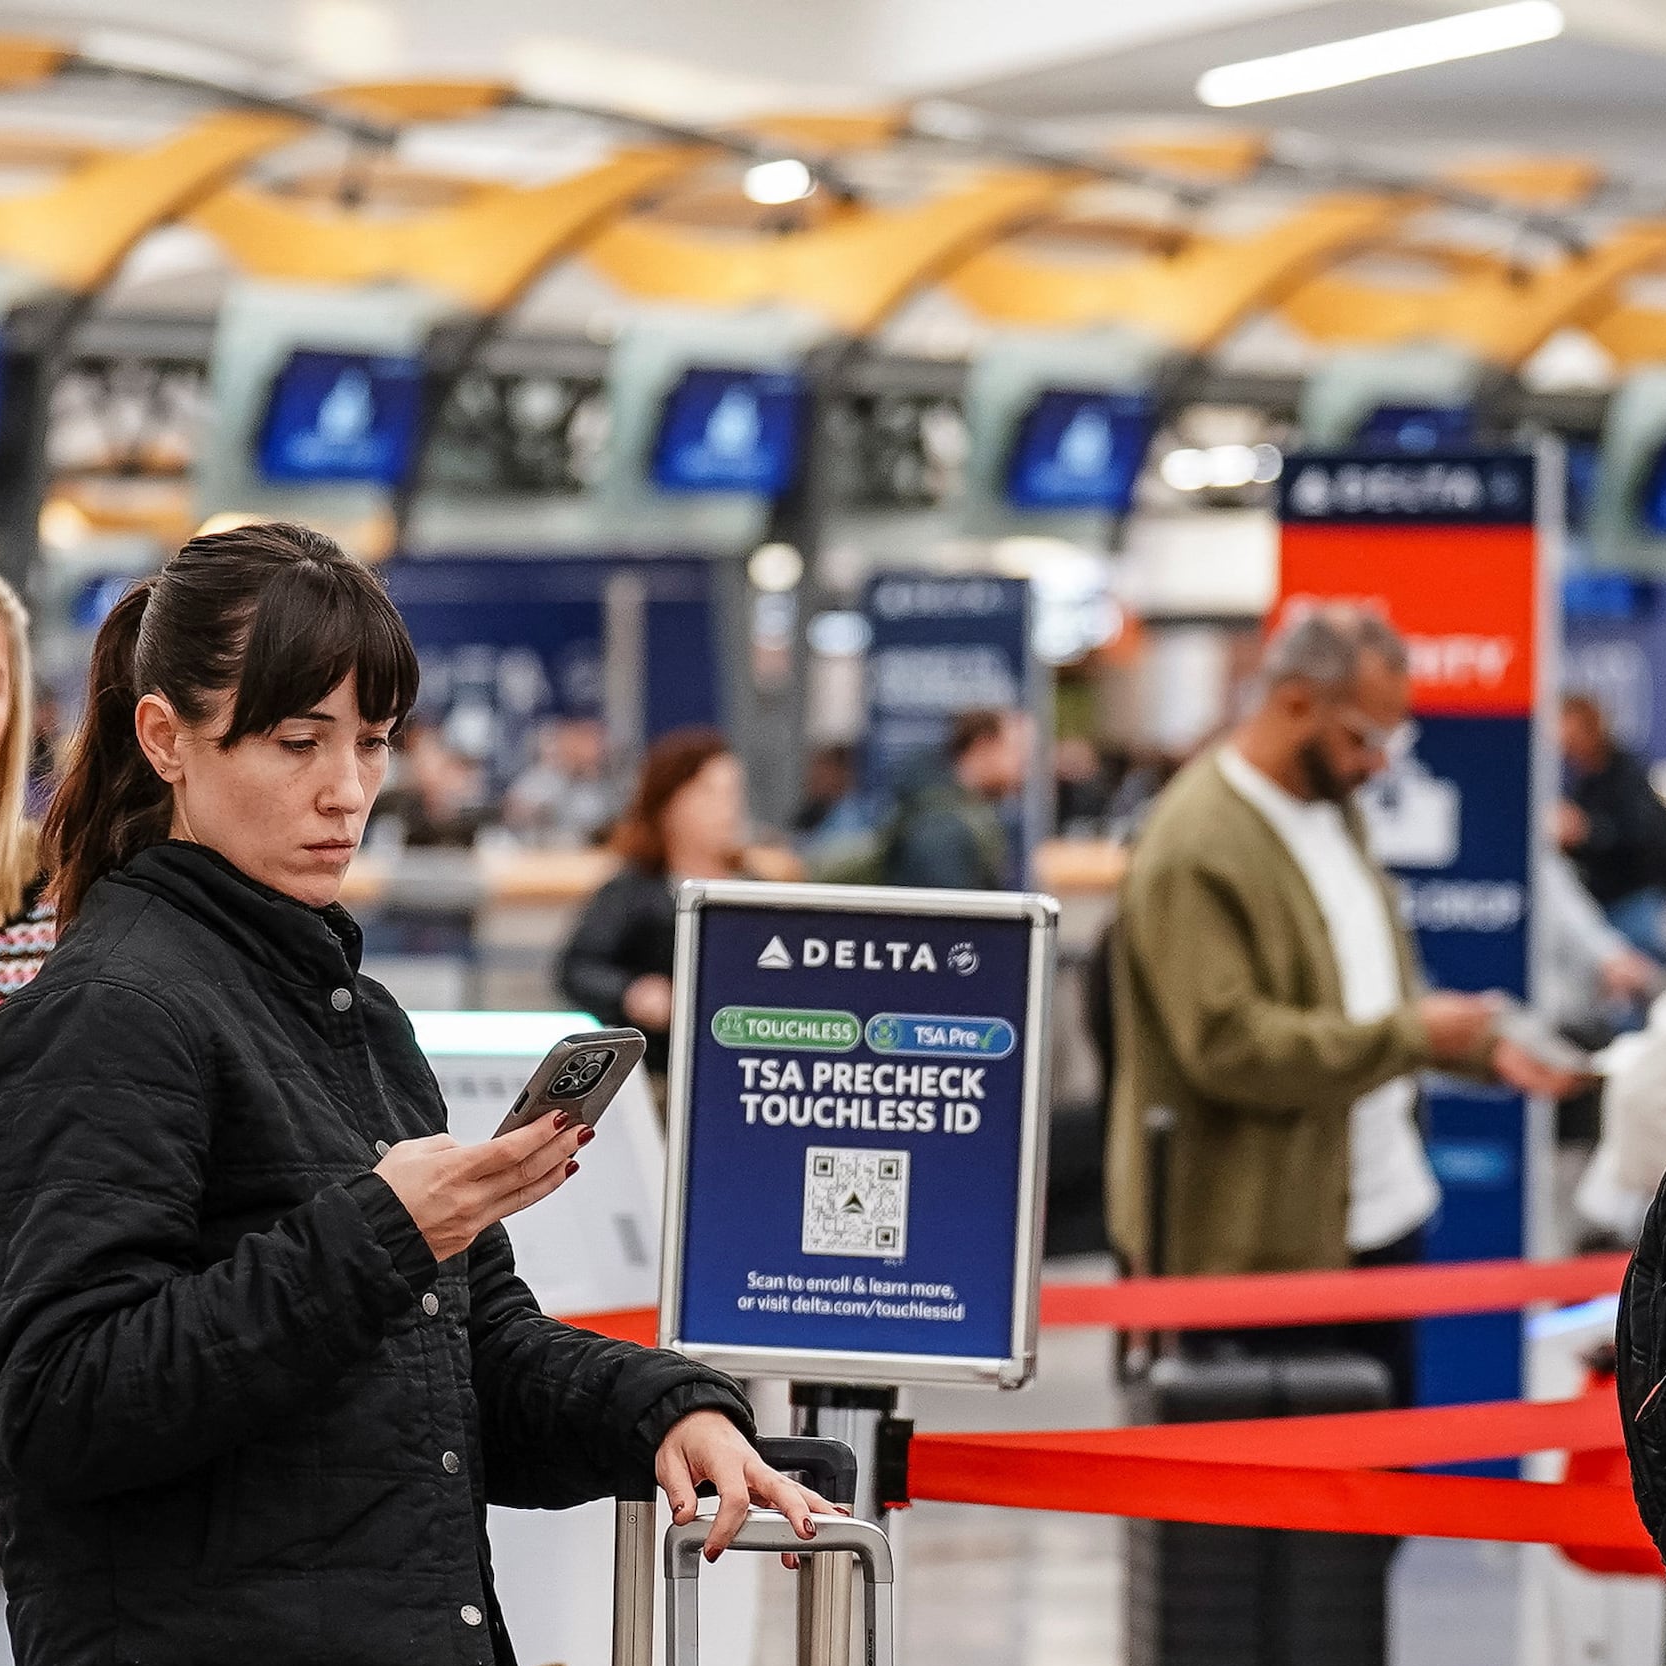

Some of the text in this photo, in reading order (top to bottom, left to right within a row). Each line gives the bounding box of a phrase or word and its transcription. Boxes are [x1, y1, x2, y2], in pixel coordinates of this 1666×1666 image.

[803, 938, 937, 972] DELTA
[746, 1018, 852, 1040] TOUCHLESS
[915, 1026, 945, 1045] TSA
[738, 1058, 986, 1099] TSA PRECHECK
[740, 1093, 981, 1134] TOUCHLESS ID
[747, 1270, 957, 1300] Scan to enroll & learn more,
[738, 1295, 965, 1321] or visit delta.com/touchlessid
